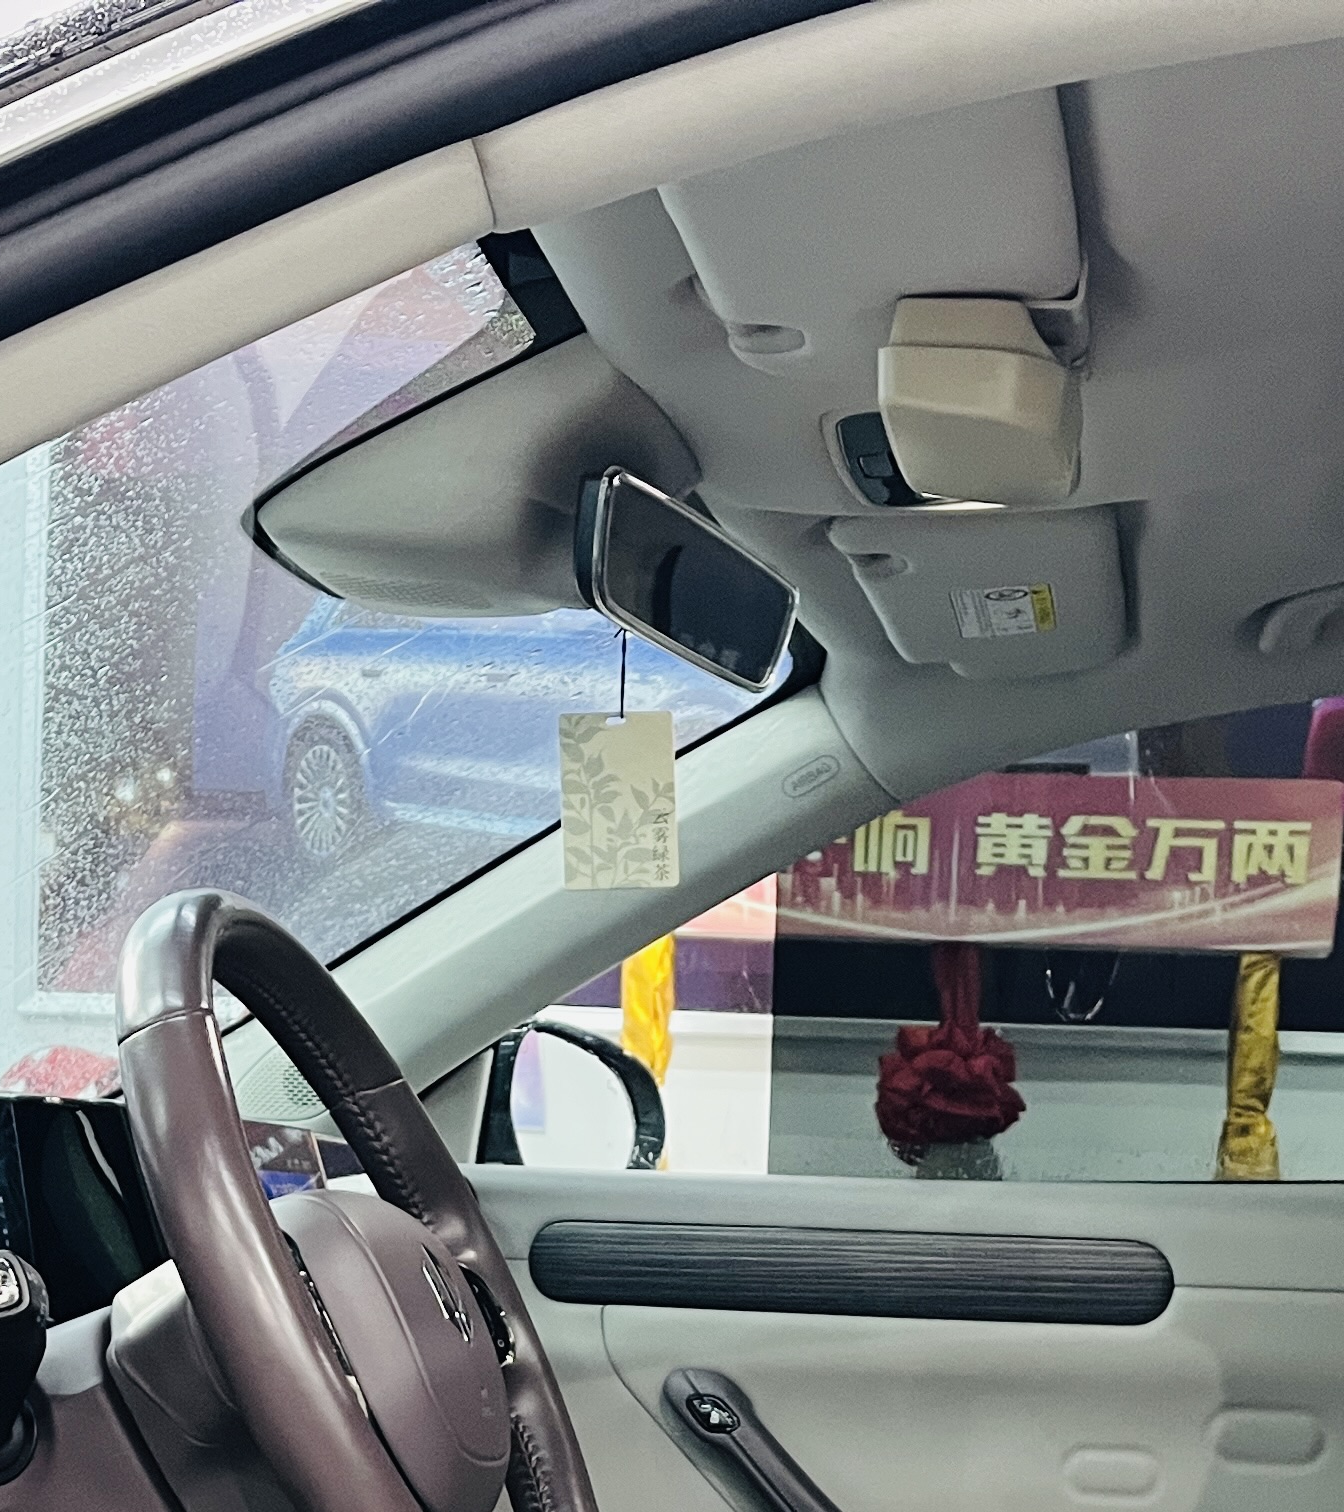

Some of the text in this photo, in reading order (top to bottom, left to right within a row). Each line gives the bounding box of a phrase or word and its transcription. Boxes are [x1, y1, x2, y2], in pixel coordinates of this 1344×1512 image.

[832, 809, 1313, 886] 响 黄金万两
